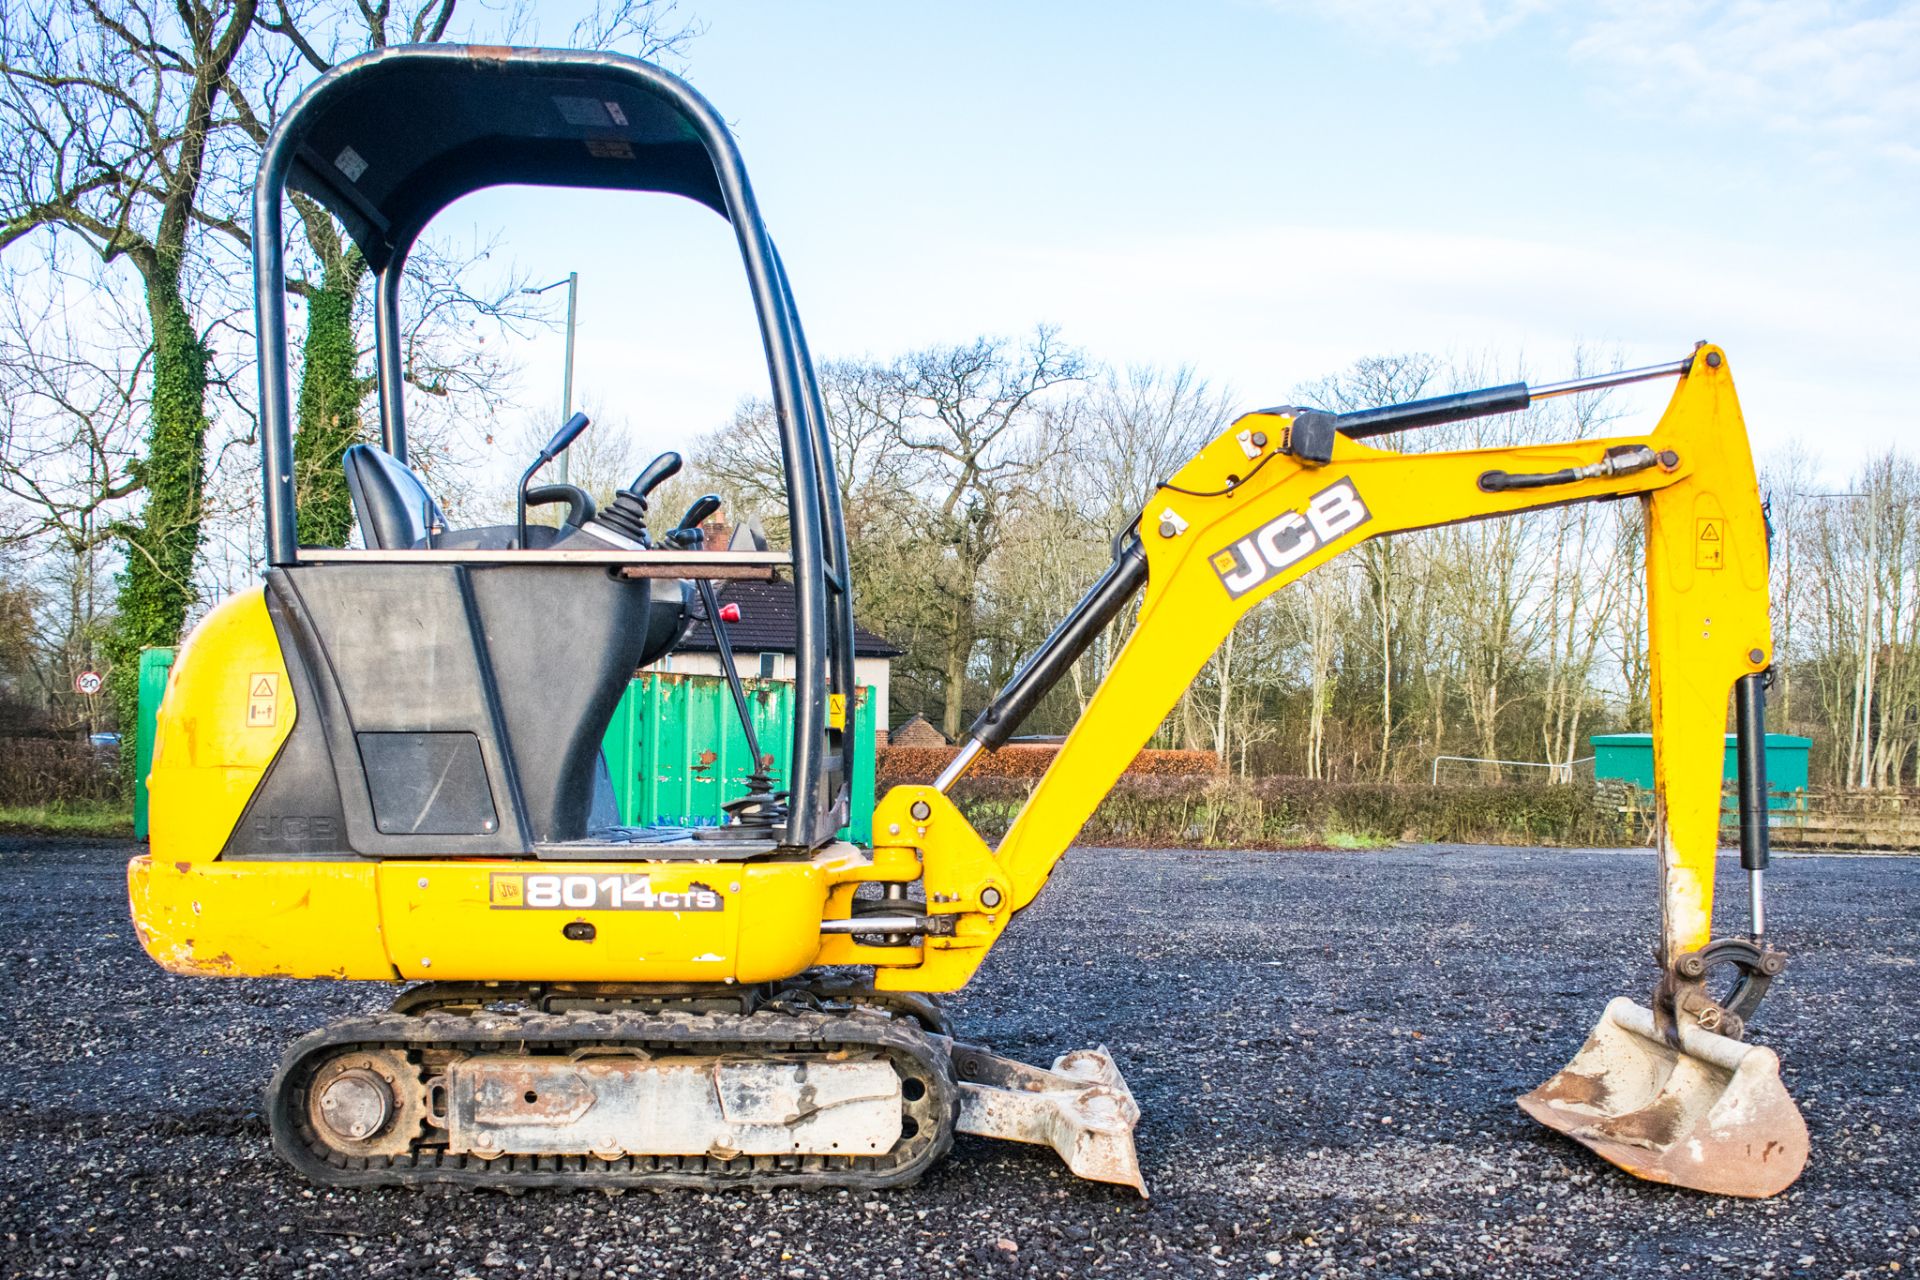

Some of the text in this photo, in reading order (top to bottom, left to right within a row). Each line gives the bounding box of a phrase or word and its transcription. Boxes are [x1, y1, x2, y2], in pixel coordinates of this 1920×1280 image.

[1224, 484, 1366, 593] JCB
[82, 678, 98, 689] 20
[254, 815, 338, 841] JCB
[501, 884, 519, 898] JCB
